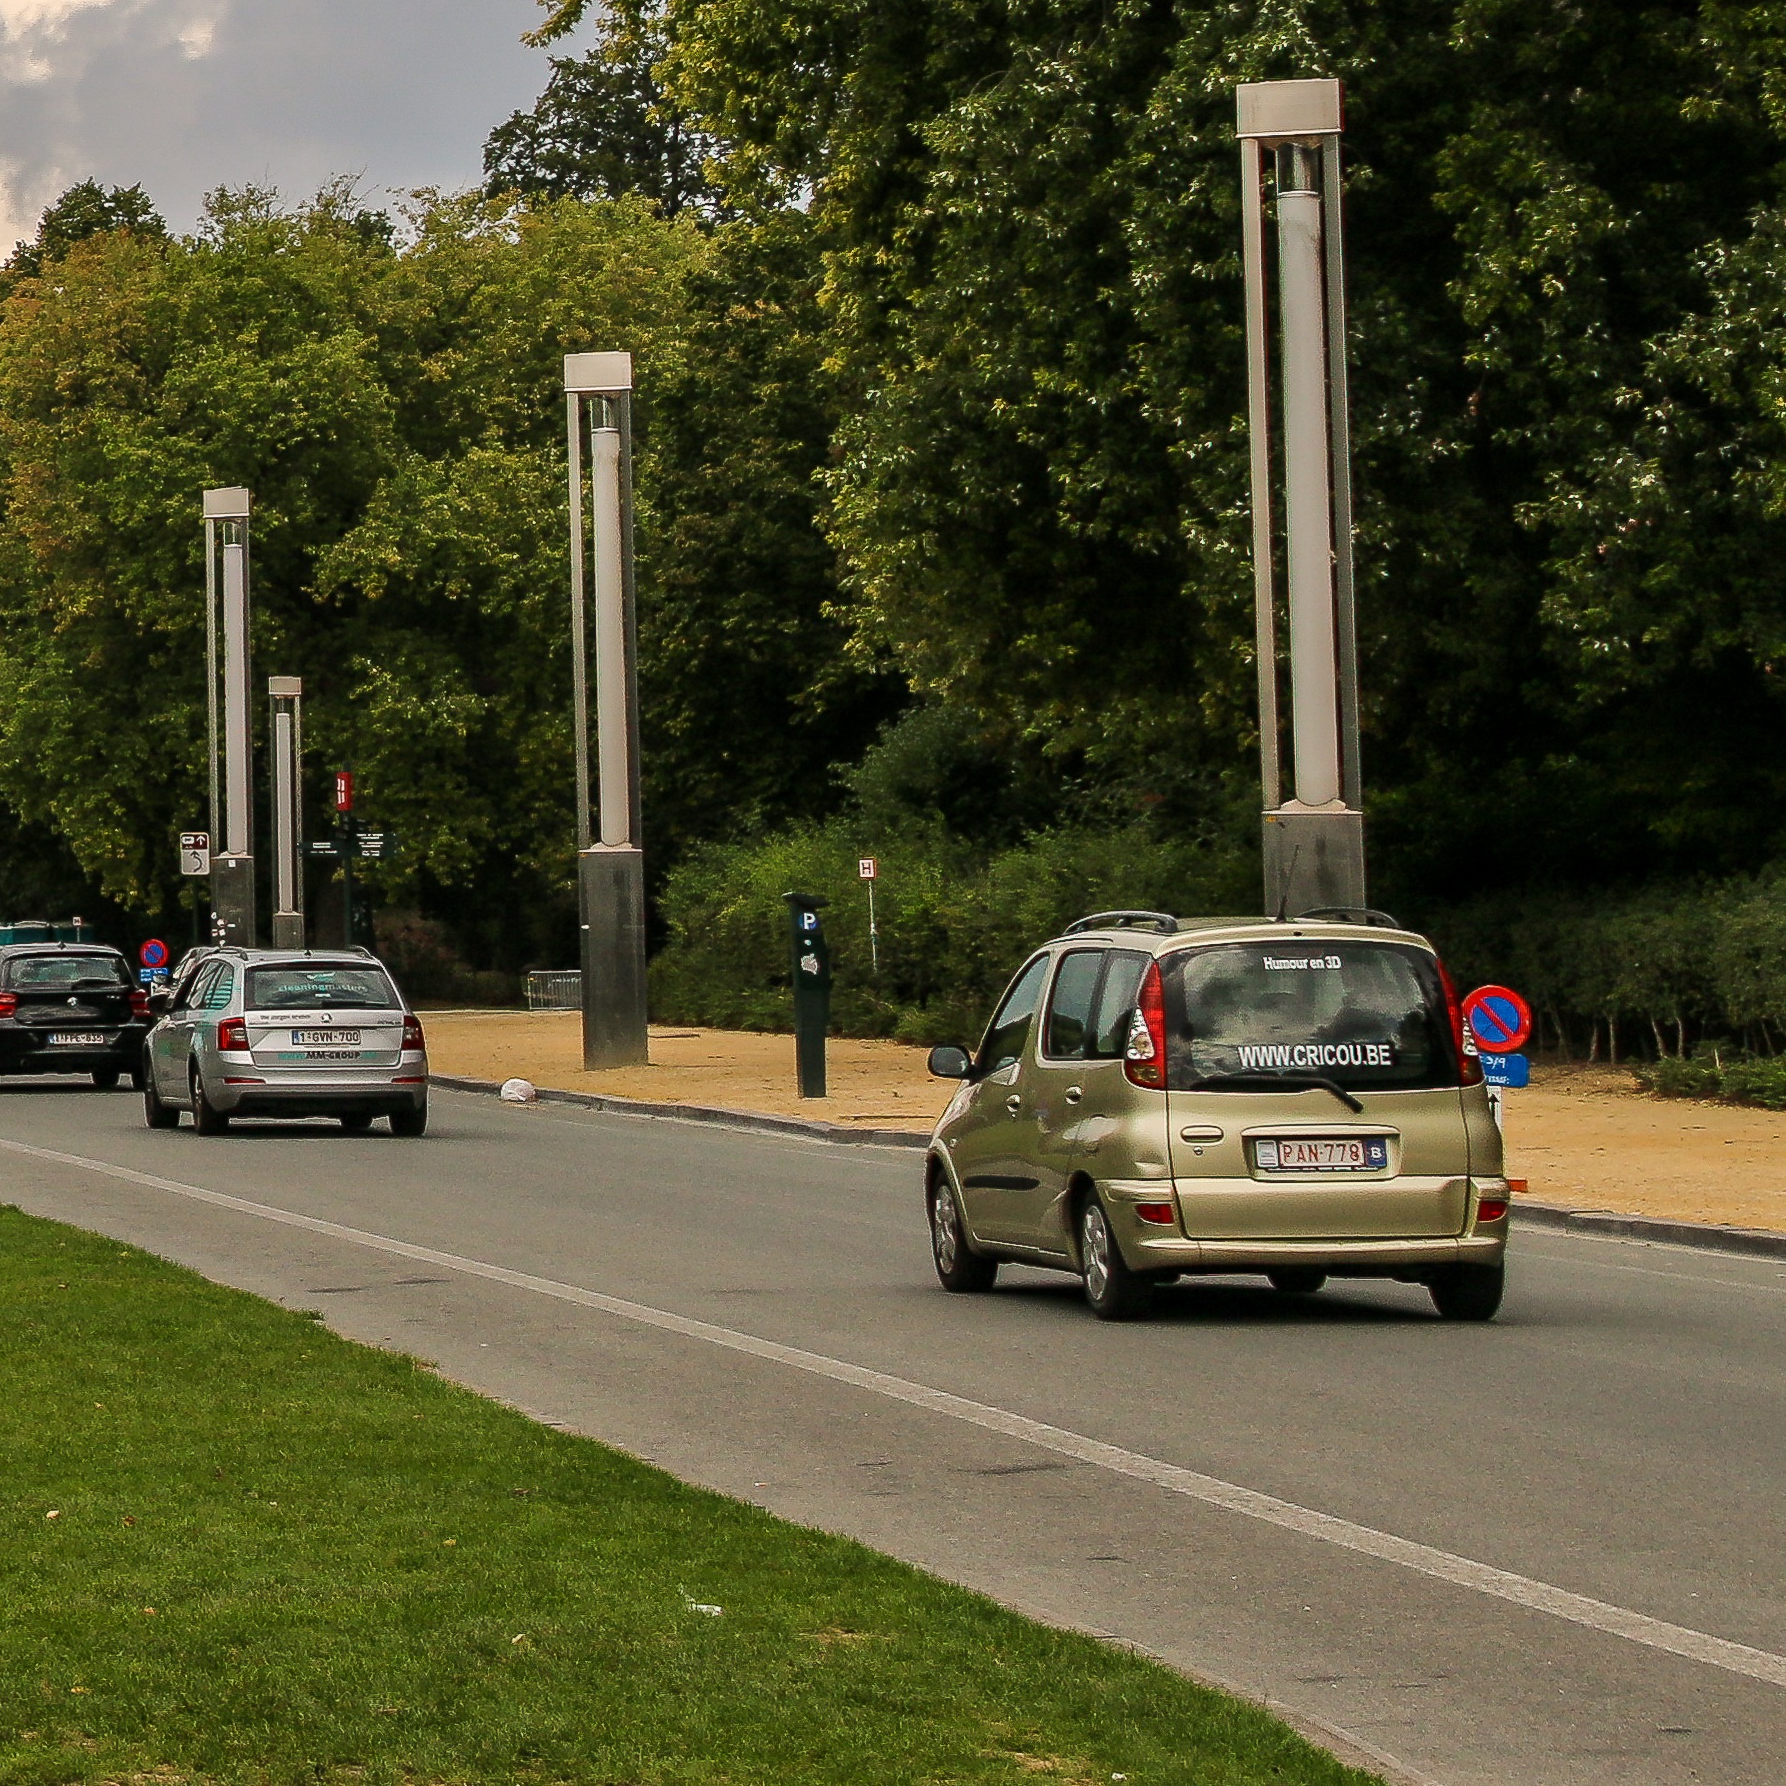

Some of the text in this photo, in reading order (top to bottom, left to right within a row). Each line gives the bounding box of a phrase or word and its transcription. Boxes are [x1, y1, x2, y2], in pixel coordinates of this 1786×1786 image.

[861, 861, 871, 875] H
[803, 912, 816, 930] P
[1263, 956, 1342, 970] Humour en 3D
[1237, 1044, 1392, 1066] WWW.CRICOU.BE
